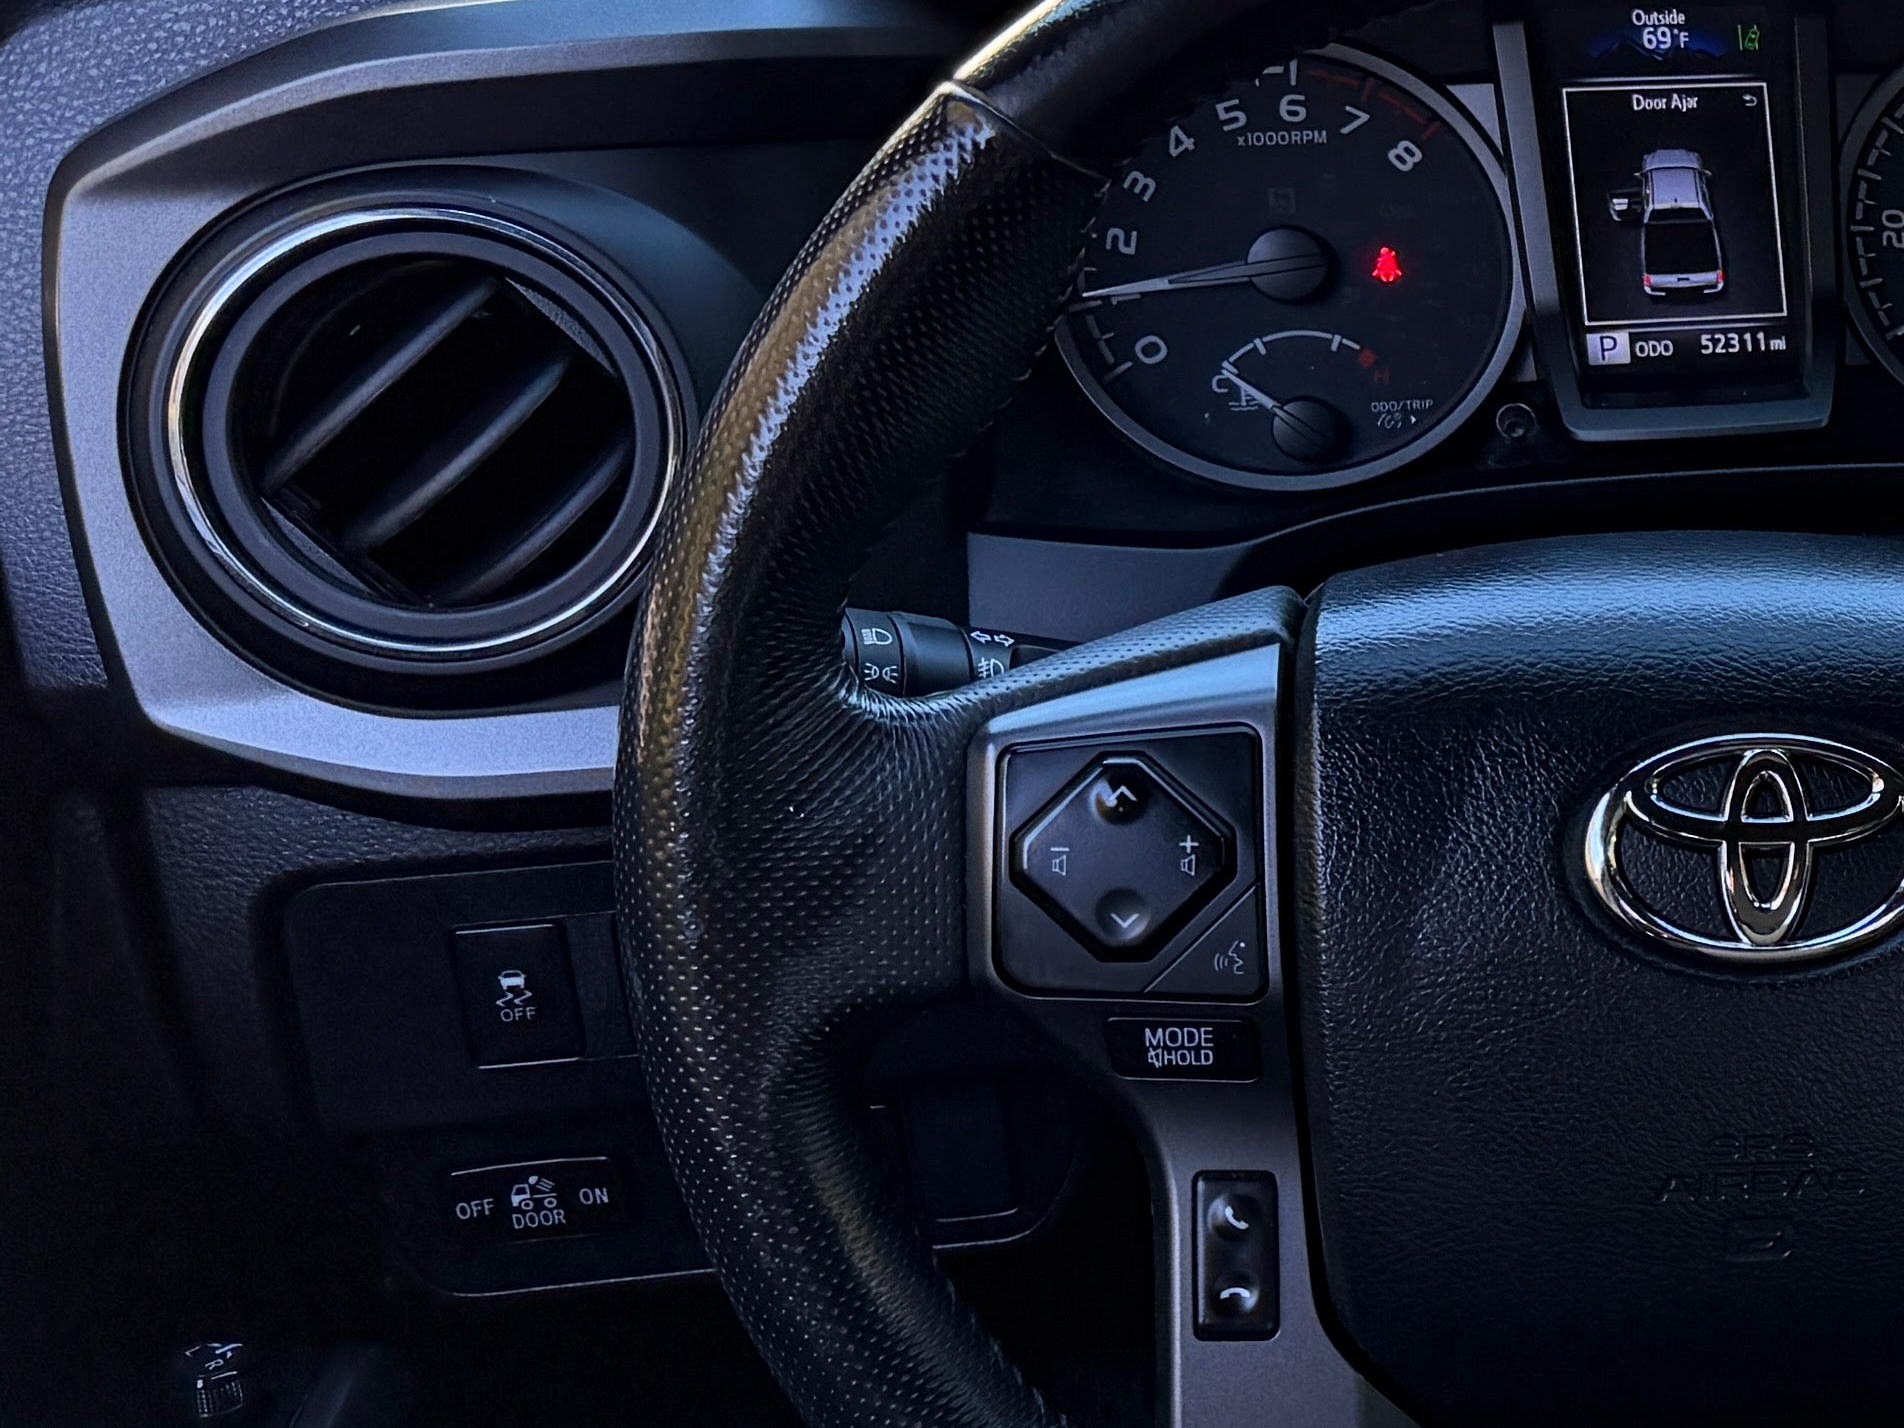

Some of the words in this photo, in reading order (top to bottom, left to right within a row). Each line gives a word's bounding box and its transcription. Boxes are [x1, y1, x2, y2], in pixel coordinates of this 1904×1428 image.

[1632, 8, 1686, 26] Outside
[1215, 98, 1248, 132] 5
[1278, 94, 1308, 123] 6
[1632, 94, 1667, 111] Door
[1671, 93, 1698, 112] Ajar
[1339, 105, 1370, 135] 7
[1168, 125, 1196, 158] 4
[1237, 130, 1327, 146] x1000RPM
[1387, 140, 1423, 172] 8
[1123, 170, 1158, 202] 3
[1105, 227, 1138, 255] 2
[1134, 334, 1168, 364] 0
[1600, 335, 1617, 361] P
[1635, 340, 1673, 357] ODO
[1701, 332, 1766, 355] 52311
[1770, 336, 1786, 351] mi
[1371, 399, 1433, 413] ODO/TRIP
[500, 1006, 536, 1023] OFF
[1144, 1026, 1214, 1048] MODE
[1163, 1049, 1214, 1066] HOLD
[1656, 1169, 1867, 1202] AIRBAG
[455, 1198, 494, 1221] OFF
[578, 1187, 609, 1206] ON
[511, 1208, 566, 1230] DOOR
